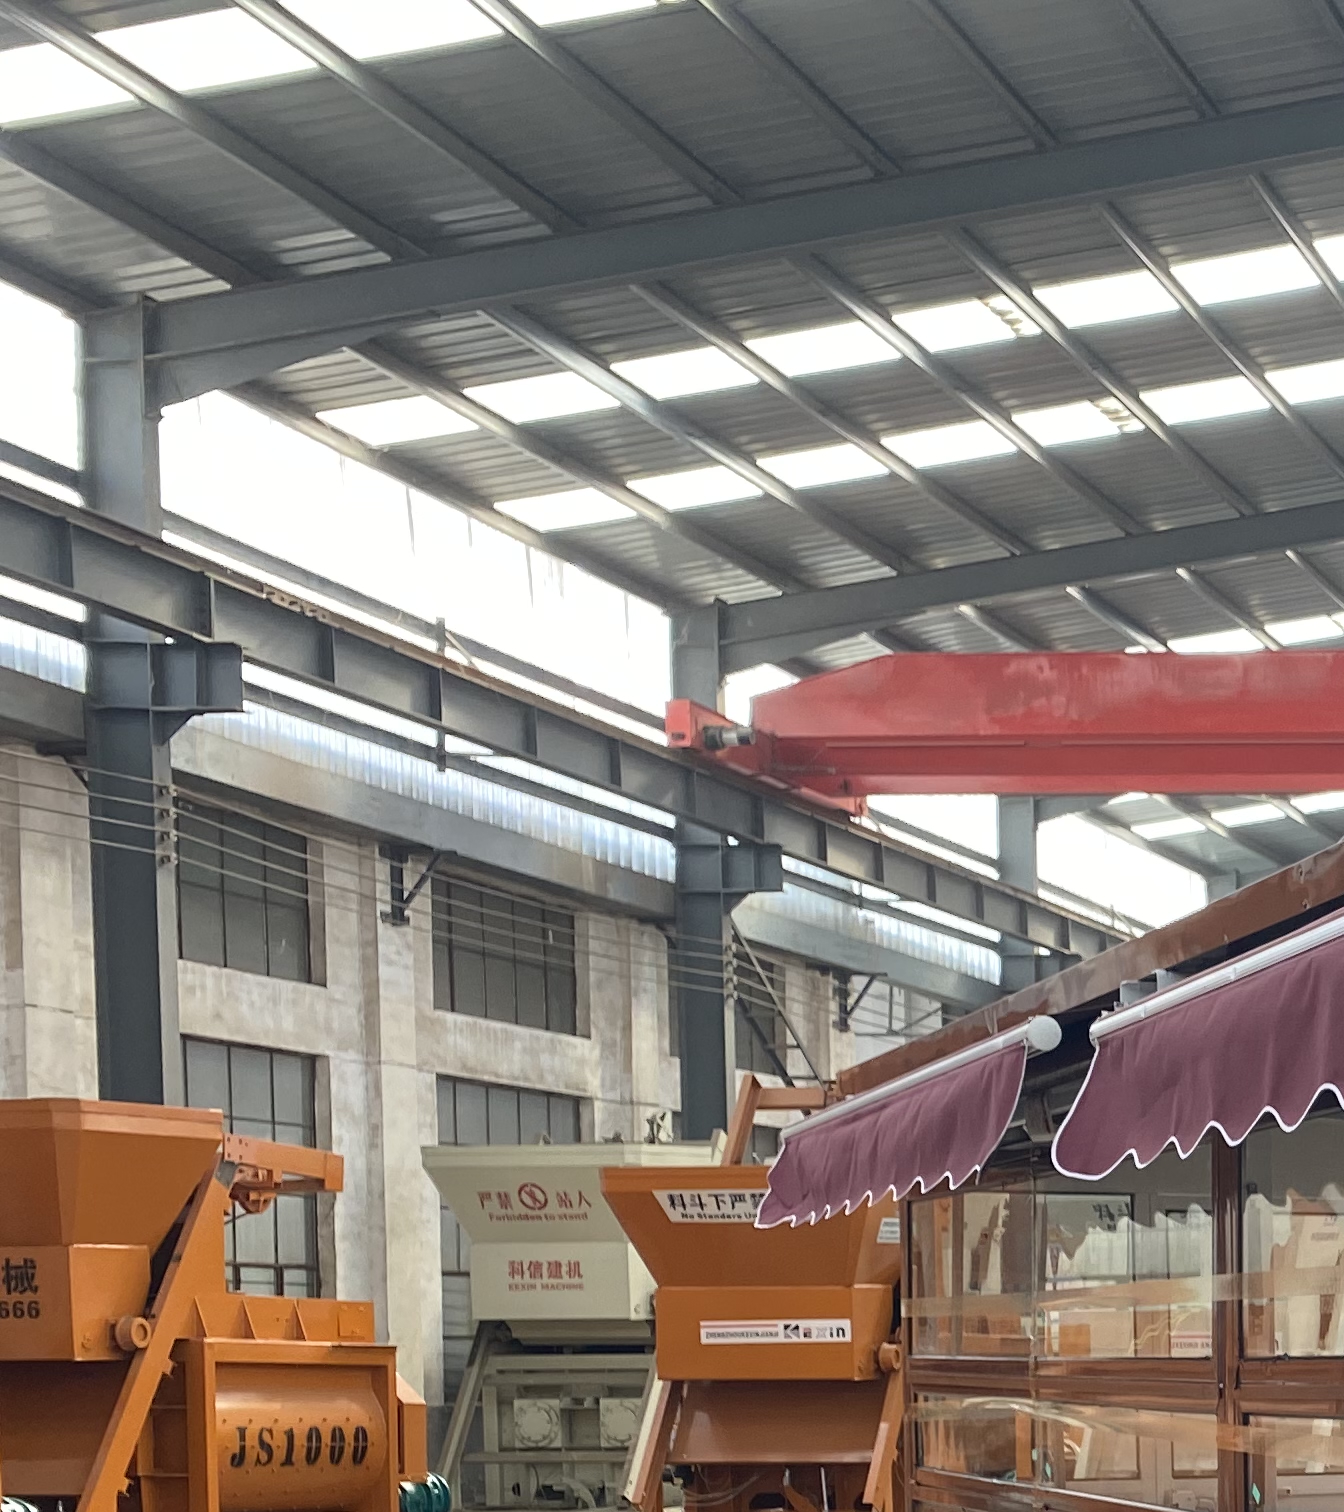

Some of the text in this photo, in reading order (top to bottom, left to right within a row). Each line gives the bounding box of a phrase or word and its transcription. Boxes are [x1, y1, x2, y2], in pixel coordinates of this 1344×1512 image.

[545, 1212, 556, 1221] to
[1, 1257, 39, 1295] 械
[508, 1260, 584, 1280] 科信建机
[508, 1282, 537, 1293] KEXIN
[0, 1300, 40, 1319] 666
[230, 1425, 369, 1468] JS1000
